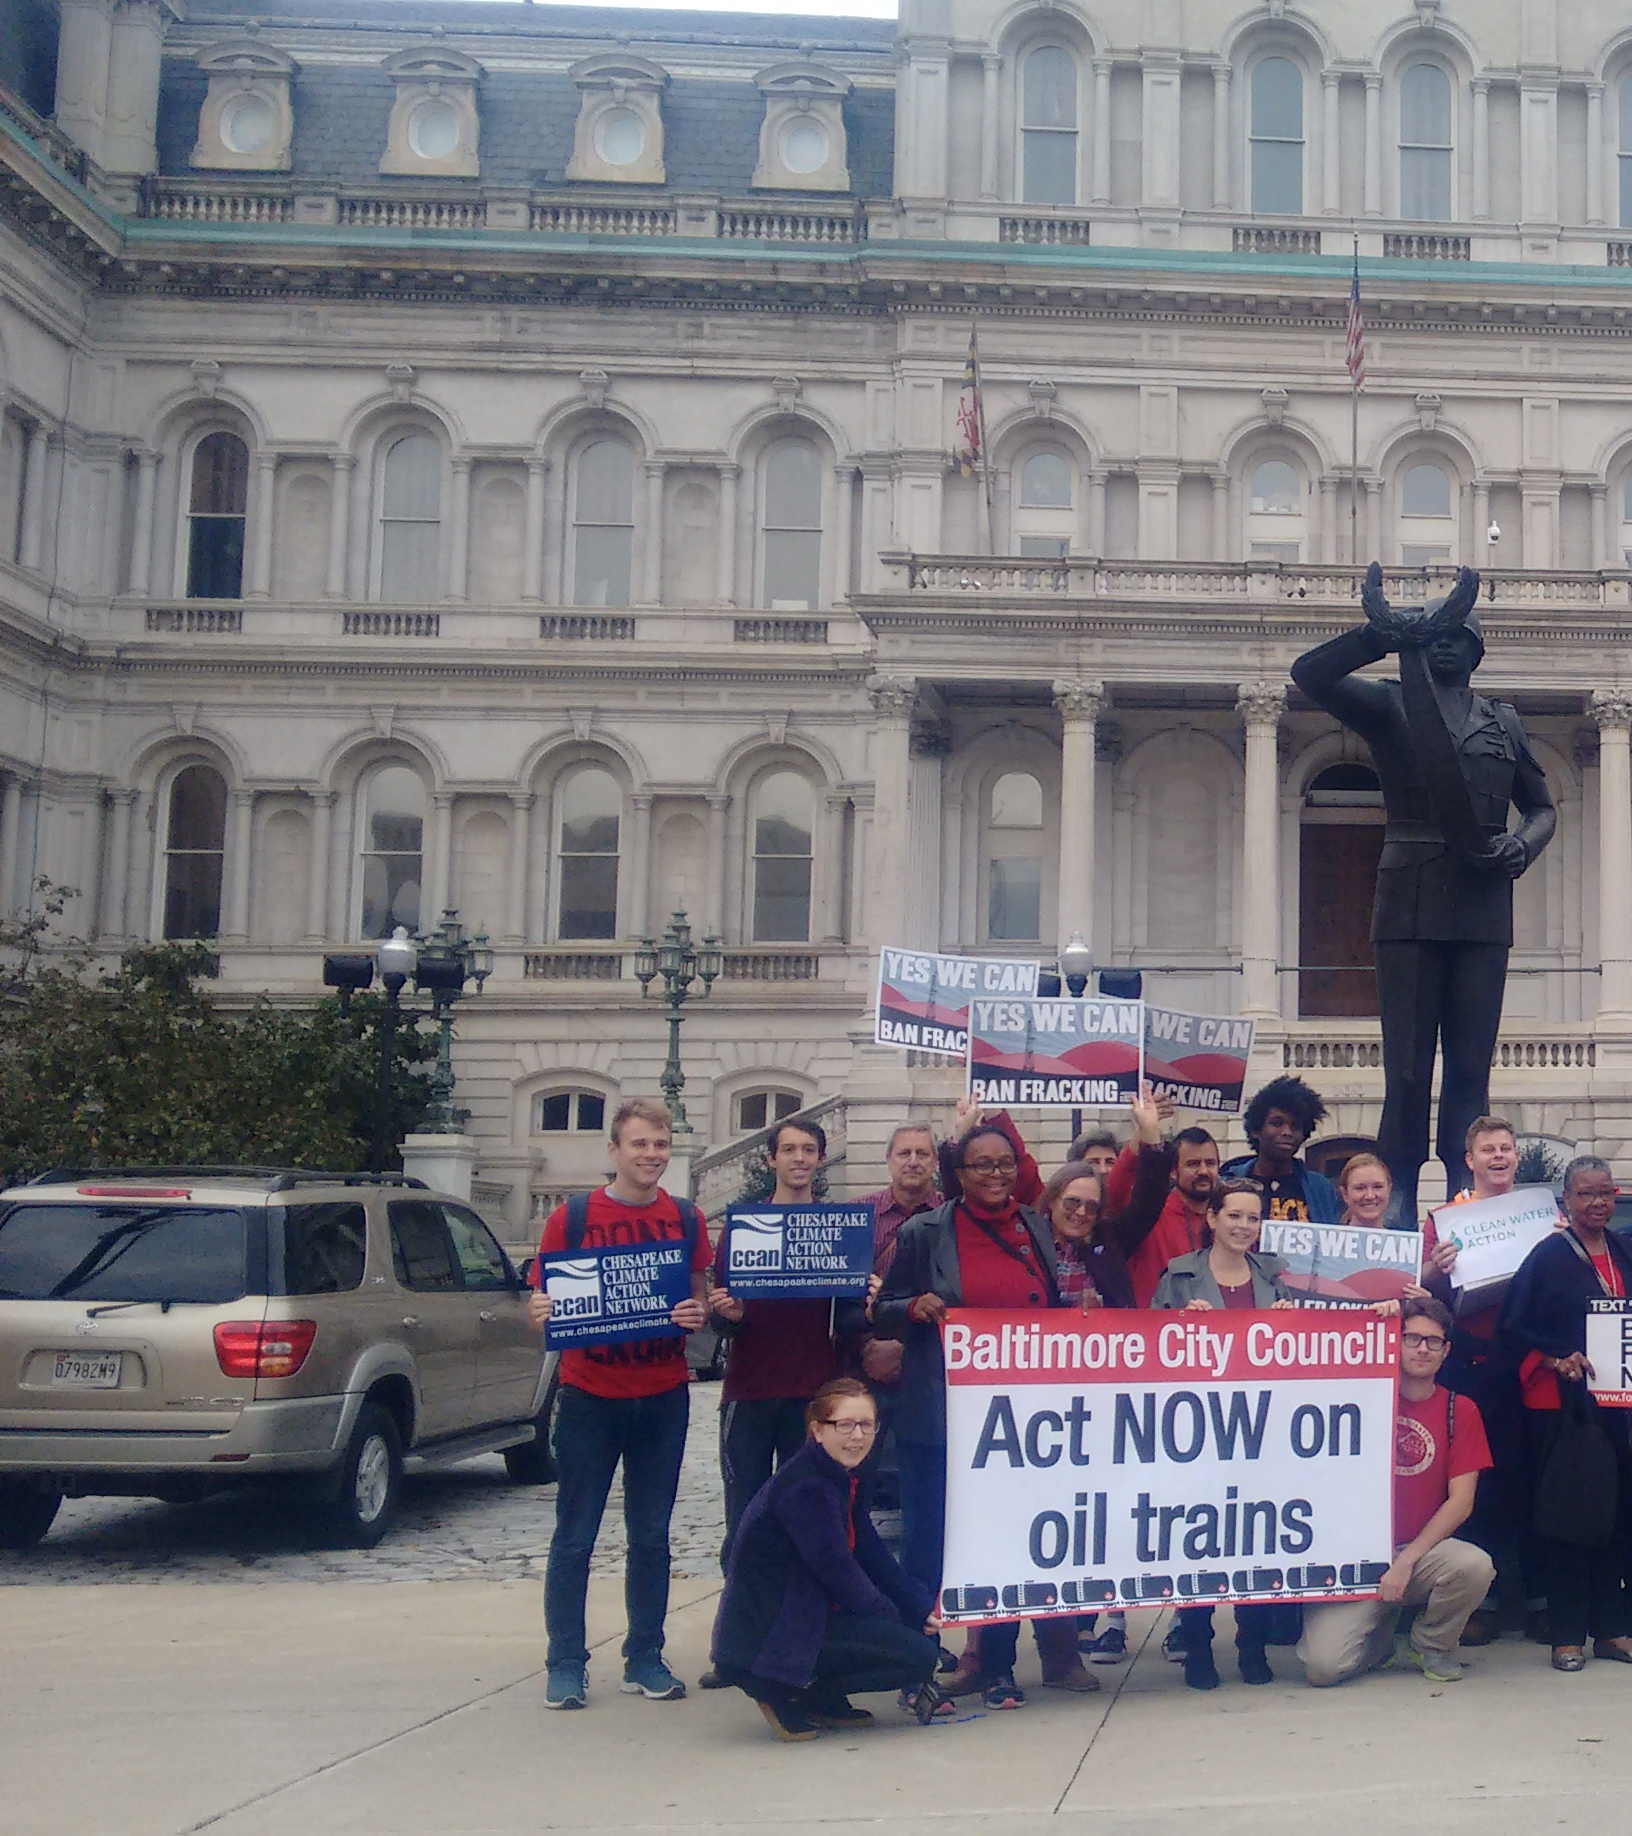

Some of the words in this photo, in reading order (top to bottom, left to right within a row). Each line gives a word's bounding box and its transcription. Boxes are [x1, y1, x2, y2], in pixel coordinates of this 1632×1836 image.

[886, 952, 930, 983] YES
[936, 959, 977, 988] WE
[984, 964, 1034, 992] CAN
[976, 1003, 1025, 1031] YES
[1032, 1004, 1075, 1032] WE
[1084, 1005, 1137, 1033] CAN
[881, 1020, 918, 1044] BAN
[922, 1027, 967, 1050] FRAC
[1151, 1011, 1193, 1043] WE
[1199, 1020, 1250, 1048] CAN
[973, 1080, 1015, 1102] BAN
[1020, 1080, 1118, 1102] FRACKING
[787, 1213, 868, 1227] CHESAPEAKE
[1464, 1219, 1506, 1236] CLEAN
[1509, 1207, 1555, 1225] WATER
[786, 1228, 842, 1241] CLIMATE
[1268, 1226, 1313, 1254] YES
[1319, 1230, 1358, 1259] WE
[1366, 1233, 1418, 1263] CAN
[1468, 1229, 1516, 1249] ACTION
[732, 1250, 779, 1267] ccan
[786, 1242, 833, 1255] ACTION
[602, 1249, 682, 1271] CHESAPEAKE
[786, 1256, 848, 1270] NETWORK
[603, 1267, 659, 1285] CLIMATE
[729, 1277, 866, 1288] www.chesapeakeclimate.org
[605, 1282, 650, 1300] ACTION
[551, 1295, 599, 1318] ccan
[605, 1295, 668, 1315] NETWORK
[1590, 1300, 1626, 1312] TEXT
[944, 1323, 1146, 1370] Baltimore
[1158, 1322, 1234, 1377] City
[1247, 1322, 1396, 1367] Council:
[971, 1395, 1092, 1469] Act
[1112, 1390, 1272, 1465] NOW
[1290, 1402, 1361, 1459] on
[1028, 1491, 1108, 1570] oil
[1131, 1485, 1314, 1563] trains
